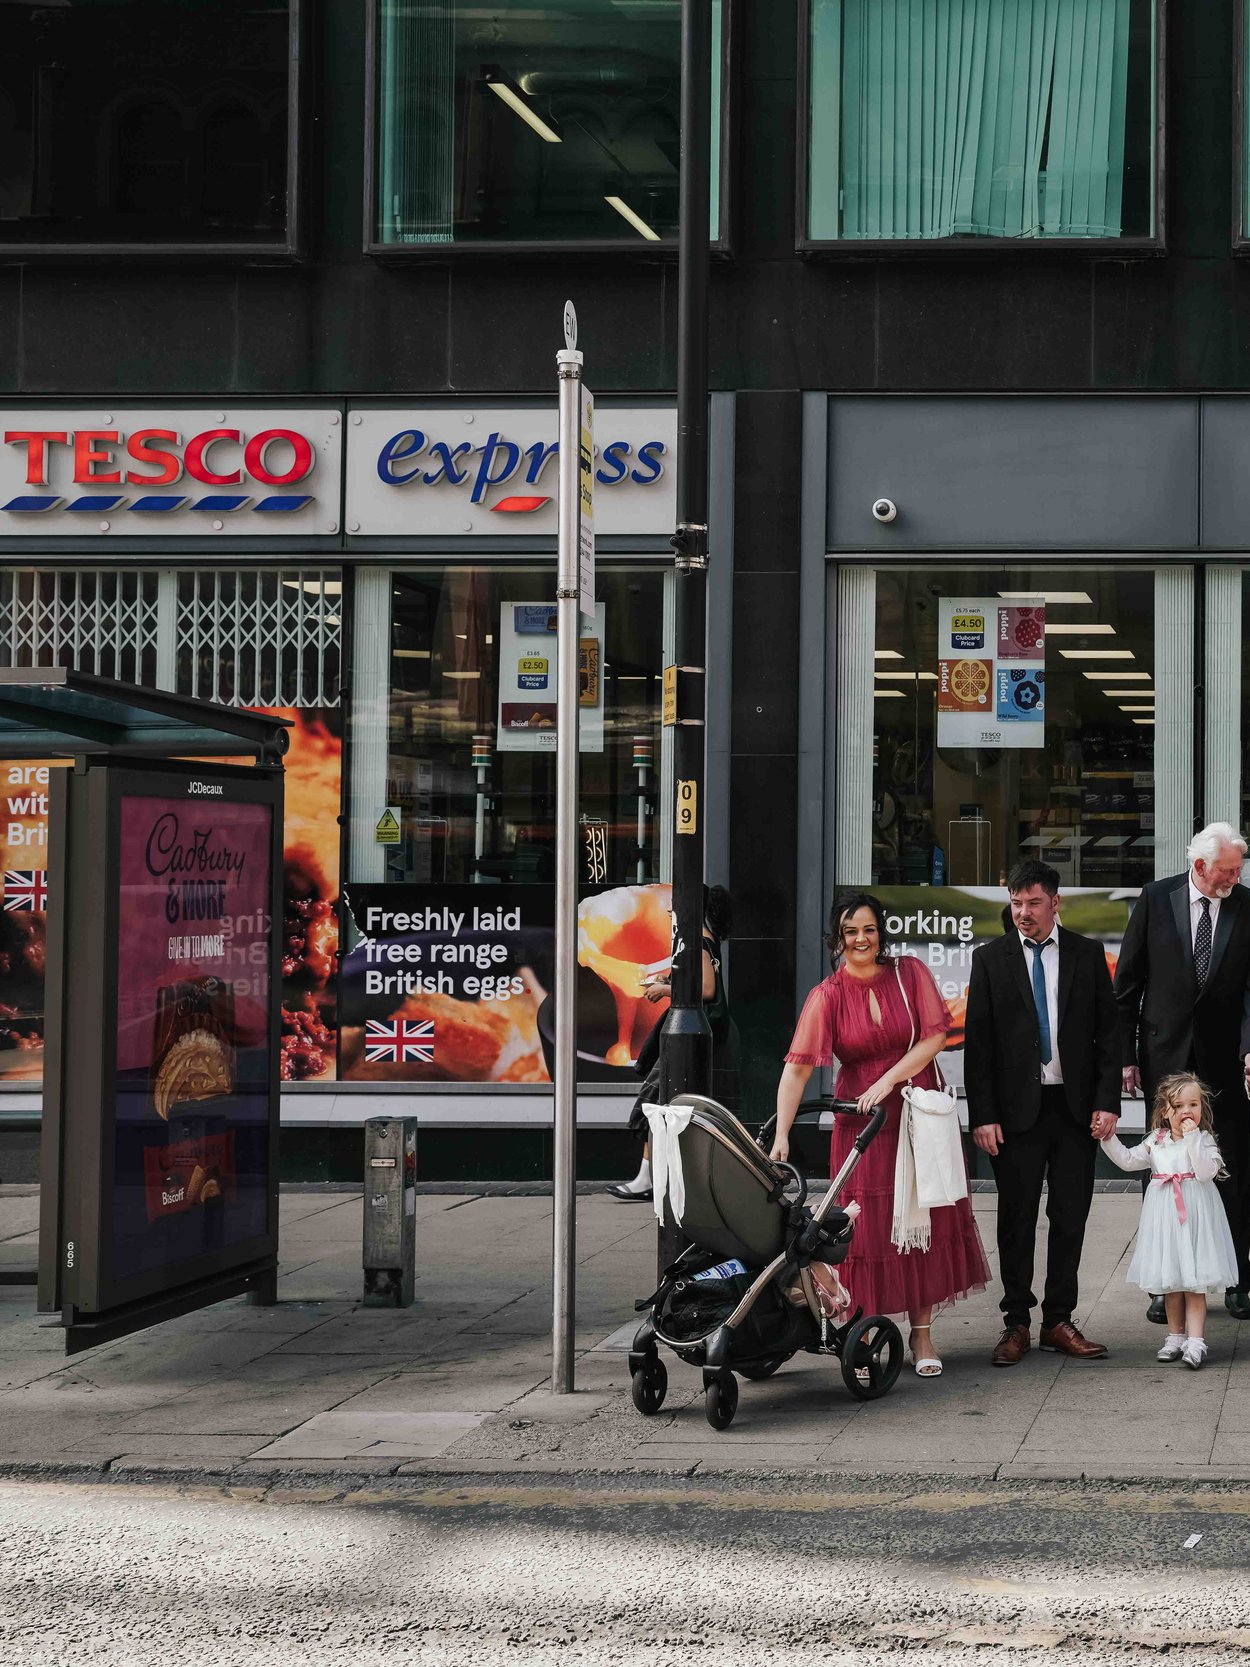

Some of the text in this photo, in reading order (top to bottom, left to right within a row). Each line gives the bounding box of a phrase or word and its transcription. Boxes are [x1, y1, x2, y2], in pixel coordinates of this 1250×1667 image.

[4, 428, 667, 504] TESCO exprss
[954, 619, 982, 629] £4.50
[999, 609, 1009, 640] poppi
[523, 661, 543, 670] £2.50
[939, 662, 949, 693] poppi
[999, 672, 1009, 703] poppi
[187, 781, 223, 795] JCDecaux
[681, 784, 692, 800] 0
[681, 808, 692, 824] 9
[145, 813, 246, 888] Cadbury
[165, 877, 227, 924] & MORE
[366, 906, 521, 936] Freshly laid
[884, 909, 973, 940] orking
[168, 934, 225, 959] GIVE IN TO MORE
[365, 938, 508, 969] free range
[366, 970, 524, 1001] British eggs
[162, 1187, 185, 1206] Biscoff
